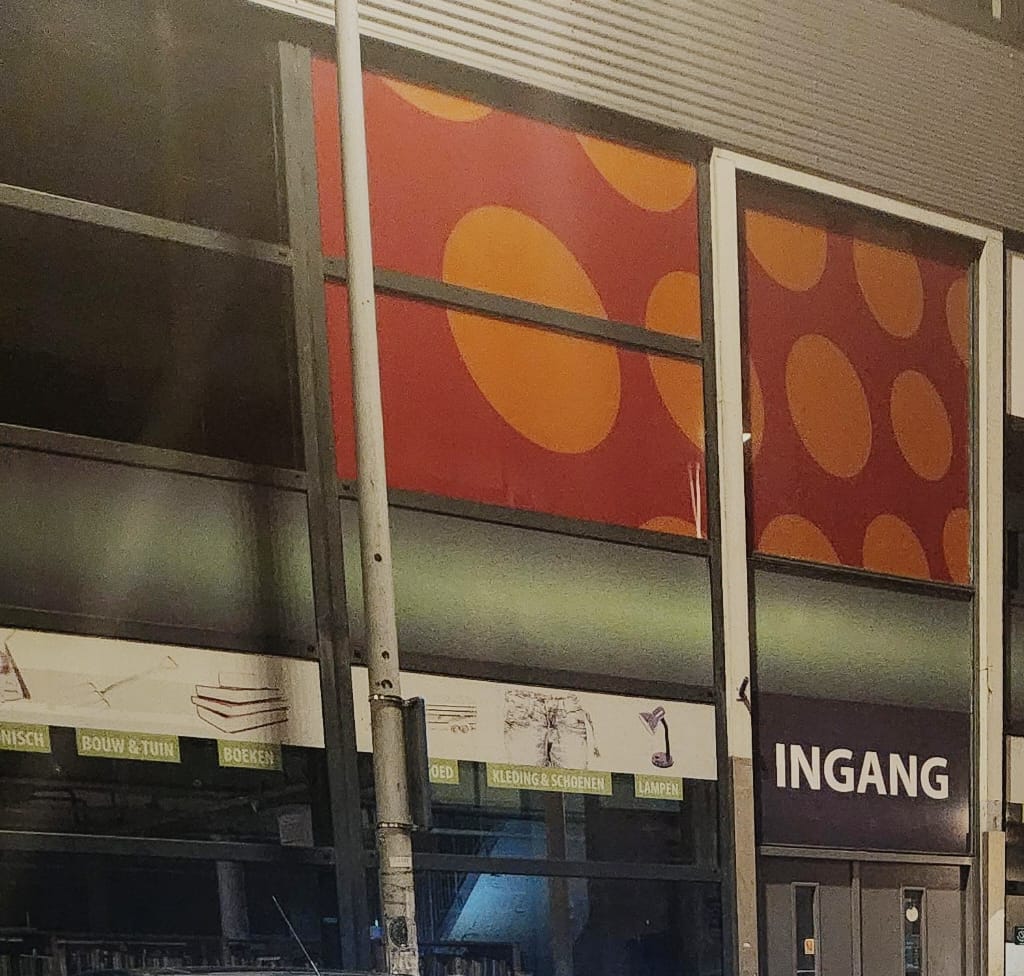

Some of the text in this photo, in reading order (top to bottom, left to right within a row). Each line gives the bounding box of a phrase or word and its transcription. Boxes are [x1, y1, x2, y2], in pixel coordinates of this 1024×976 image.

[81, 735, 174, 757] BOUW & TUIN
[223, 747, 274, 766] BOEKEN
[492, 771, 605, 791] KLEDING & SCHOENEN
[775, 742, 949, 800] INGANG
[638, 780, 680, 795] LAMPEN
